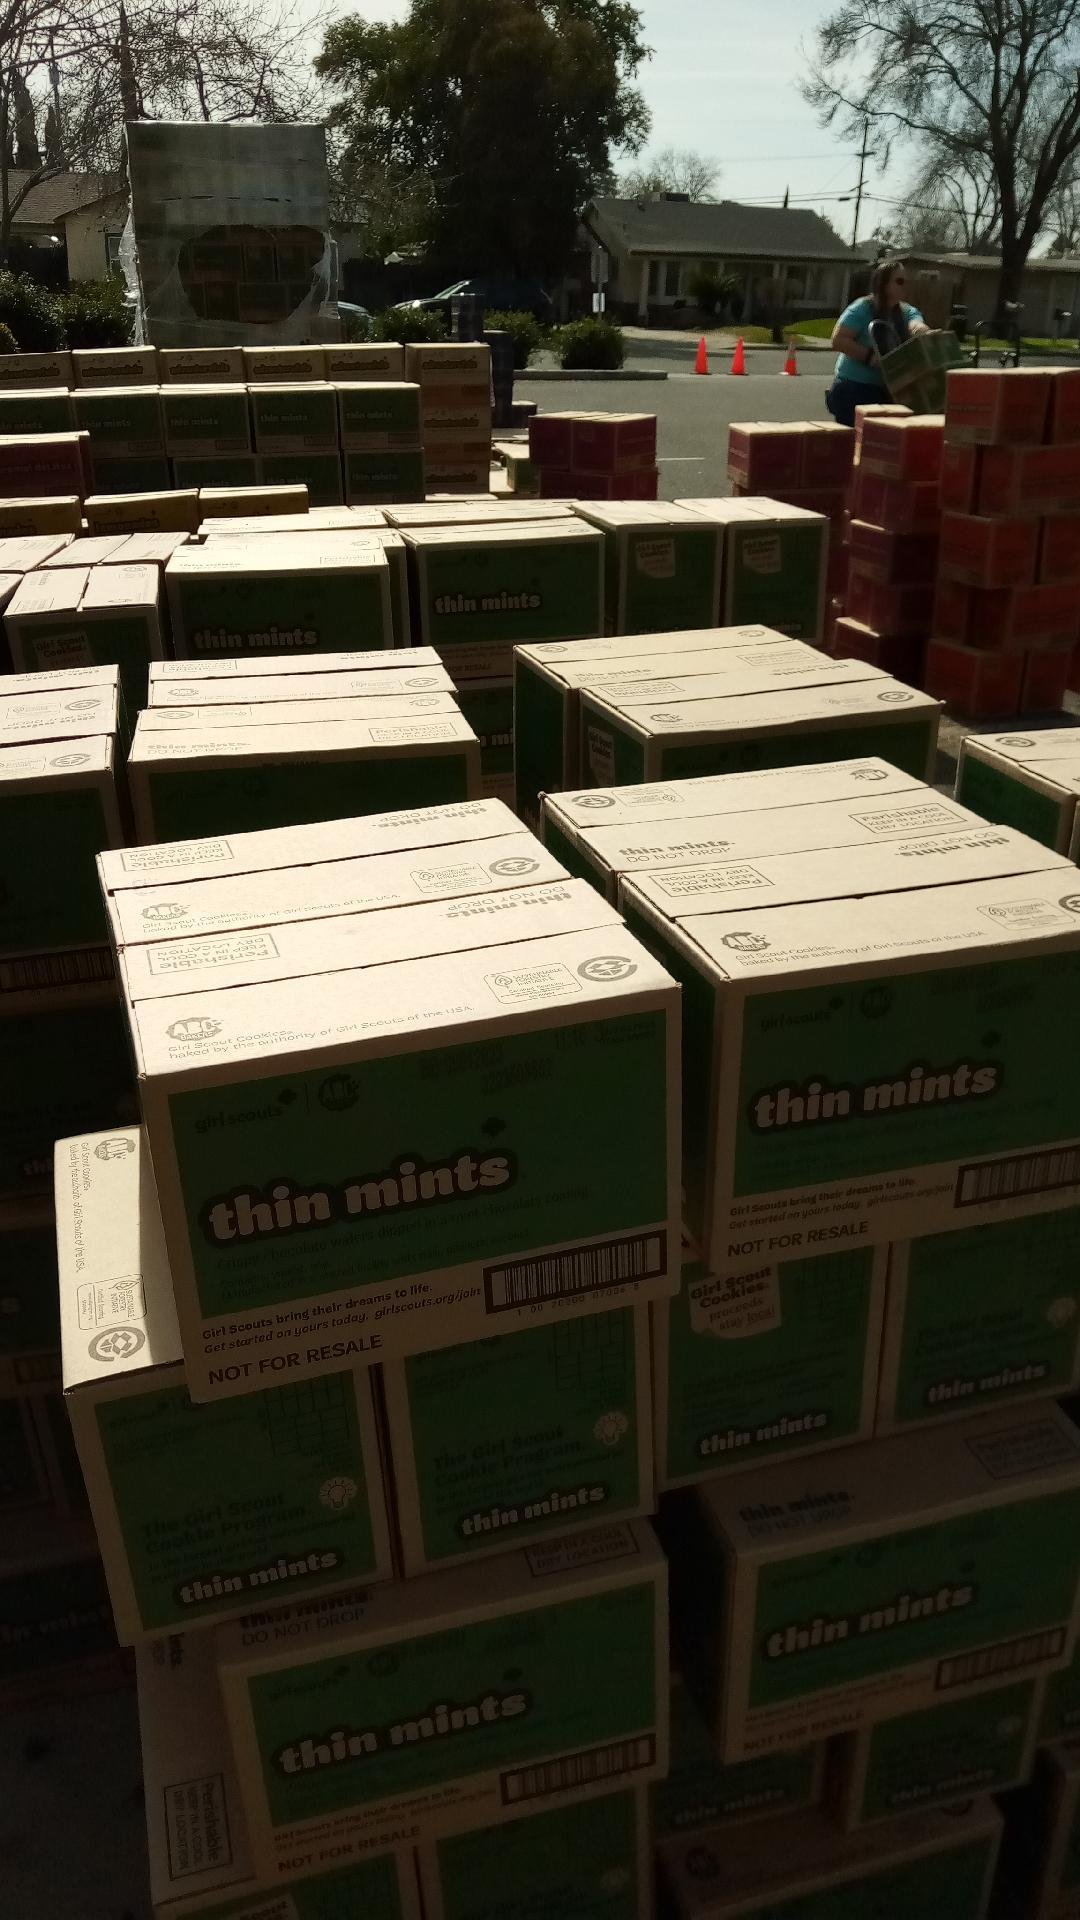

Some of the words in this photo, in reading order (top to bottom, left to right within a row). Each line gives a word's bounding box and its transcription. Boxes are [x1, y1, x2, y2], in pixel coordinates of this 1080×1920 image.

[434, 593, 477, 613] thin
[481, 591, 541, 610] mints
[193, 628, 243, 649] thin
[248, 626, 317, 647] mints
[861, 805, 942, 822] Perishable
[618, 845, 664, 857] thin
[626, 855, 650, 864] DO
[653, 852, 685, 862] NOT
[689, 847, 731, 859] DROP
[966, 837, 1011, 849] thin
[502, 889, 536, 901] NOT
[523, 892, 572, 905] thin
[540, 886, 565, 894] DO
[670, 878, 763, 894] Perishable
[447, 898, 495, 911] DROP
[157, 939, 232, 956] LOCATION
[159, 949, 269, 969] Perishable
[735, 953, 762, 962] Girl
[763, 950, 788, 960] Scout
[743, 958, 772, 968] baked
[810, 946, 860, 960] authority
[892, 937, 925, 948] Scouts
[168, 1044, 191, 1053] Girl
[194, 1038, 233, 1050] Scout
[169, 1048, 210, 1059] baked
[234, 1041, 255, 1049] the
[257, 1032, 316, 1048] authority
[337, 1024, 358, 1033] Girl
[361, 1017, 402, 1030] Scouts
[755, 1082, 850, 1128] thin
[863, 1064, 997, 1111] mints
[208, 1185, 331, 1240] thin
[344, 1155, 511, 1214] mints
[730, 1204, 750, 1216] Girl
[752, 1200, 787, 1214] Scouts
[789, 1194, 817, 1208] bring
[818, 1189, 844, 1202] their
[845, 1183, 883, 1197] dreams
[885, 1180, 897, 1189] to
[729, 1220, 746, 1230] Get
[747, 1212, 786, 1228] started
[787, 1209, 800, 1219] on
[801, 1205, 831, 1218] yours
[727, 1238, 764, 1257] NOT
[768, 1231, 803, 1250] FOR
[807, 1220, 870, 1242] RESALE
[691, 1280, 722, 1299] Girl
[725, 1266, 771, 1288] Scout
[700, 1282, 767, 1308] Cookies
[202, 1326, 226, 1341] Girl
[229, 1318, 273, 1335] Scouts
[276, 1308, 310, 1323] bring
[311, 1302, 342, 1317] their
[345, 1292, 392, 1309] dreams
[395, 1288, 407, 1299] to
[409, 1283, 433, 1296] life.
[204, 1341, 227, 1354] Get
[229, 1331, 274, 1350] started
[276, 1329, 292, 1339] on
[293, 1320, 329, 1338] yours
[332, 1312, 369, 1329] today.
[374, 1287, 481, 1320] girlscouts.org/join
[209, 1361, 252, 1384] NOT
[258, 1352, 301, 1374] FOR
[306, 1334, 384, 1364] RESALE
[929, 1379, 974, 1403] thin
[979, 1363, 1046, 1390] mints
[700, 1430, 751, 1454] thin
[756, 1411, 827, 1441] mints
[143, 1521, 180, 1538] The
[185, 1508, 222, 1530] Girl
[229, 1492, 284, 1515] Scout
[461, 1509, 519, 1536] thin
[524, 1486, 605, 1520] mints
[740, 1503, 790, 1524] thin
[180, 1576, 243, 1603] thin
[249, 1552, 338, 1586] mints
[242, 1628, 269, 1647] DO
[274, 1619, 313, 1639] NOT
[317, 1608, 366, 1631] DROP
[766, 1618, 849, 1658] thin
[858, 1584, 973, 1632] mints
[279, 1730, 378, 1774] thin
[389, 1693, 527, 1745] mints
[202, 1782, 220, 1863] Perishable
[277, 1853, 314, 1872] NOT
[319, 1842, 355, 1864] FOR
[358, 1824, 422, 1854] RESALE
